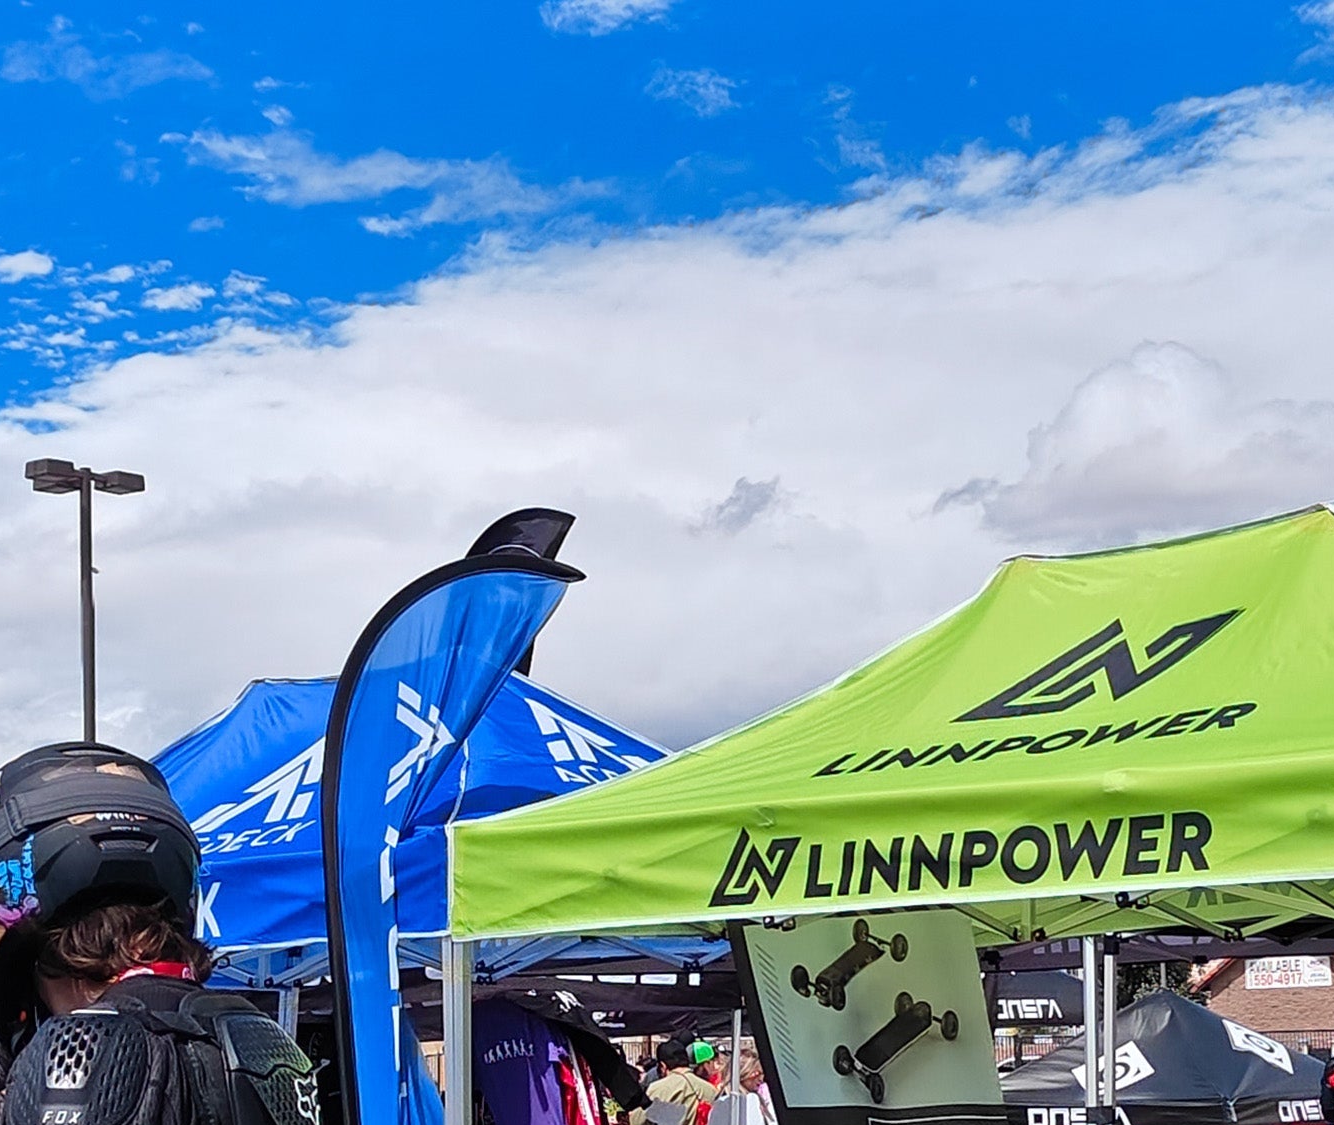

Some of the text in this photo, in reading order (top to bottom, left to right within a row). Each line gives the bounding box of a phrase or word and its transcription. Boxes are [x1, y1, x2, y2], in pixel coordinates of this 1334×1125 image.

[812, 702, 1257, 778] LINNPOWER
[806, 811, 1213, 899] LINNPOWER
[41, 1110, 82, 1125] FOX
